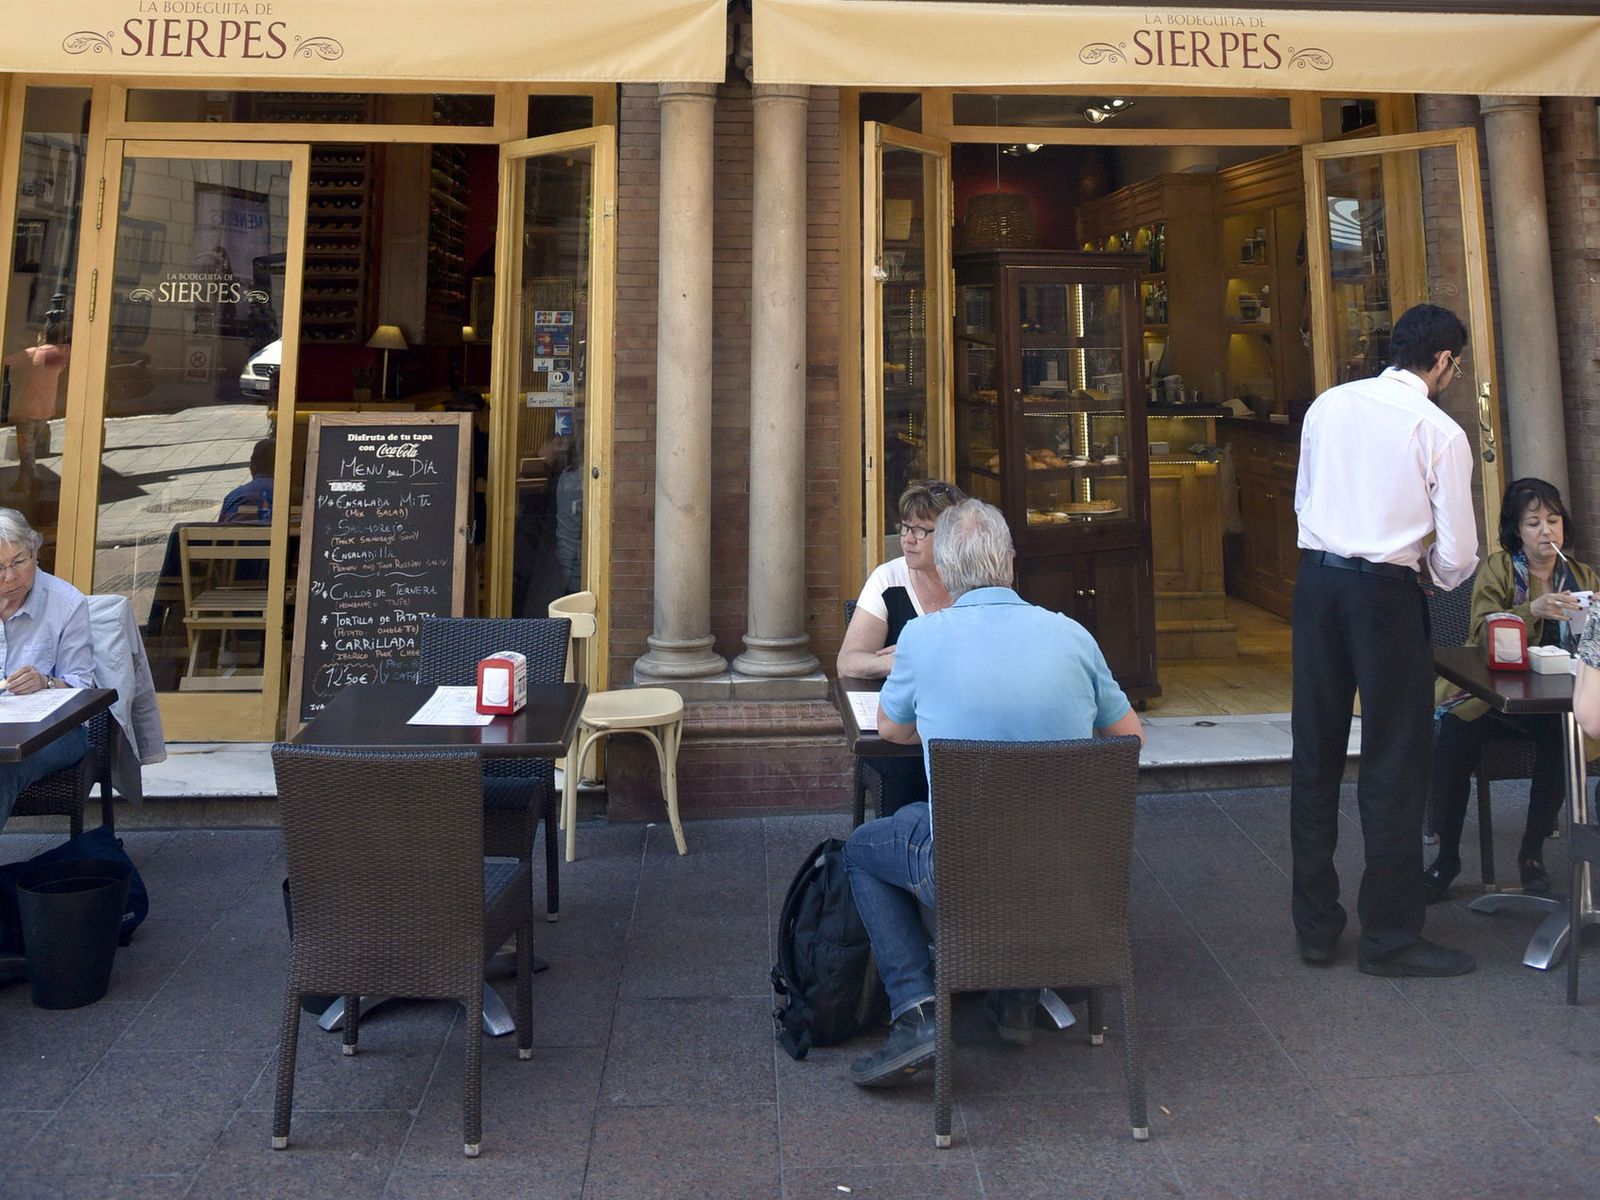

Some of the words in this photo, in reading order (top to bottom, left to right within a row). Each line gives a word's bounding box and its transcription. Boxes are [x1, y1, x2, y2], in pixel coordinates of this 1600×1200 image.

[139, 0, 158, 13] LA
[164, 1, 250, 15] BODEGUITA
[255, 2, 273, 16] DE
[1144, 13, 1163, 25] LA
[1167, 14, 1246, 28] BODEGUITA
[1250, 16, 1267, 28] DE
[121, 18, 288, 60] SIERPES
[1132, 29, 1282, 70] SIERPES
[166, 272, 177, 280] LA
[178, 272, 222, 281] BODEGUITA
[223, 273, 234, 281] DE
[158, 281, 241, 304] SIERPES
[347, 433, 386, 441] Disfruta
[412, 434, 433, 442] tapa
[340, 456, 384, 478] MENU
